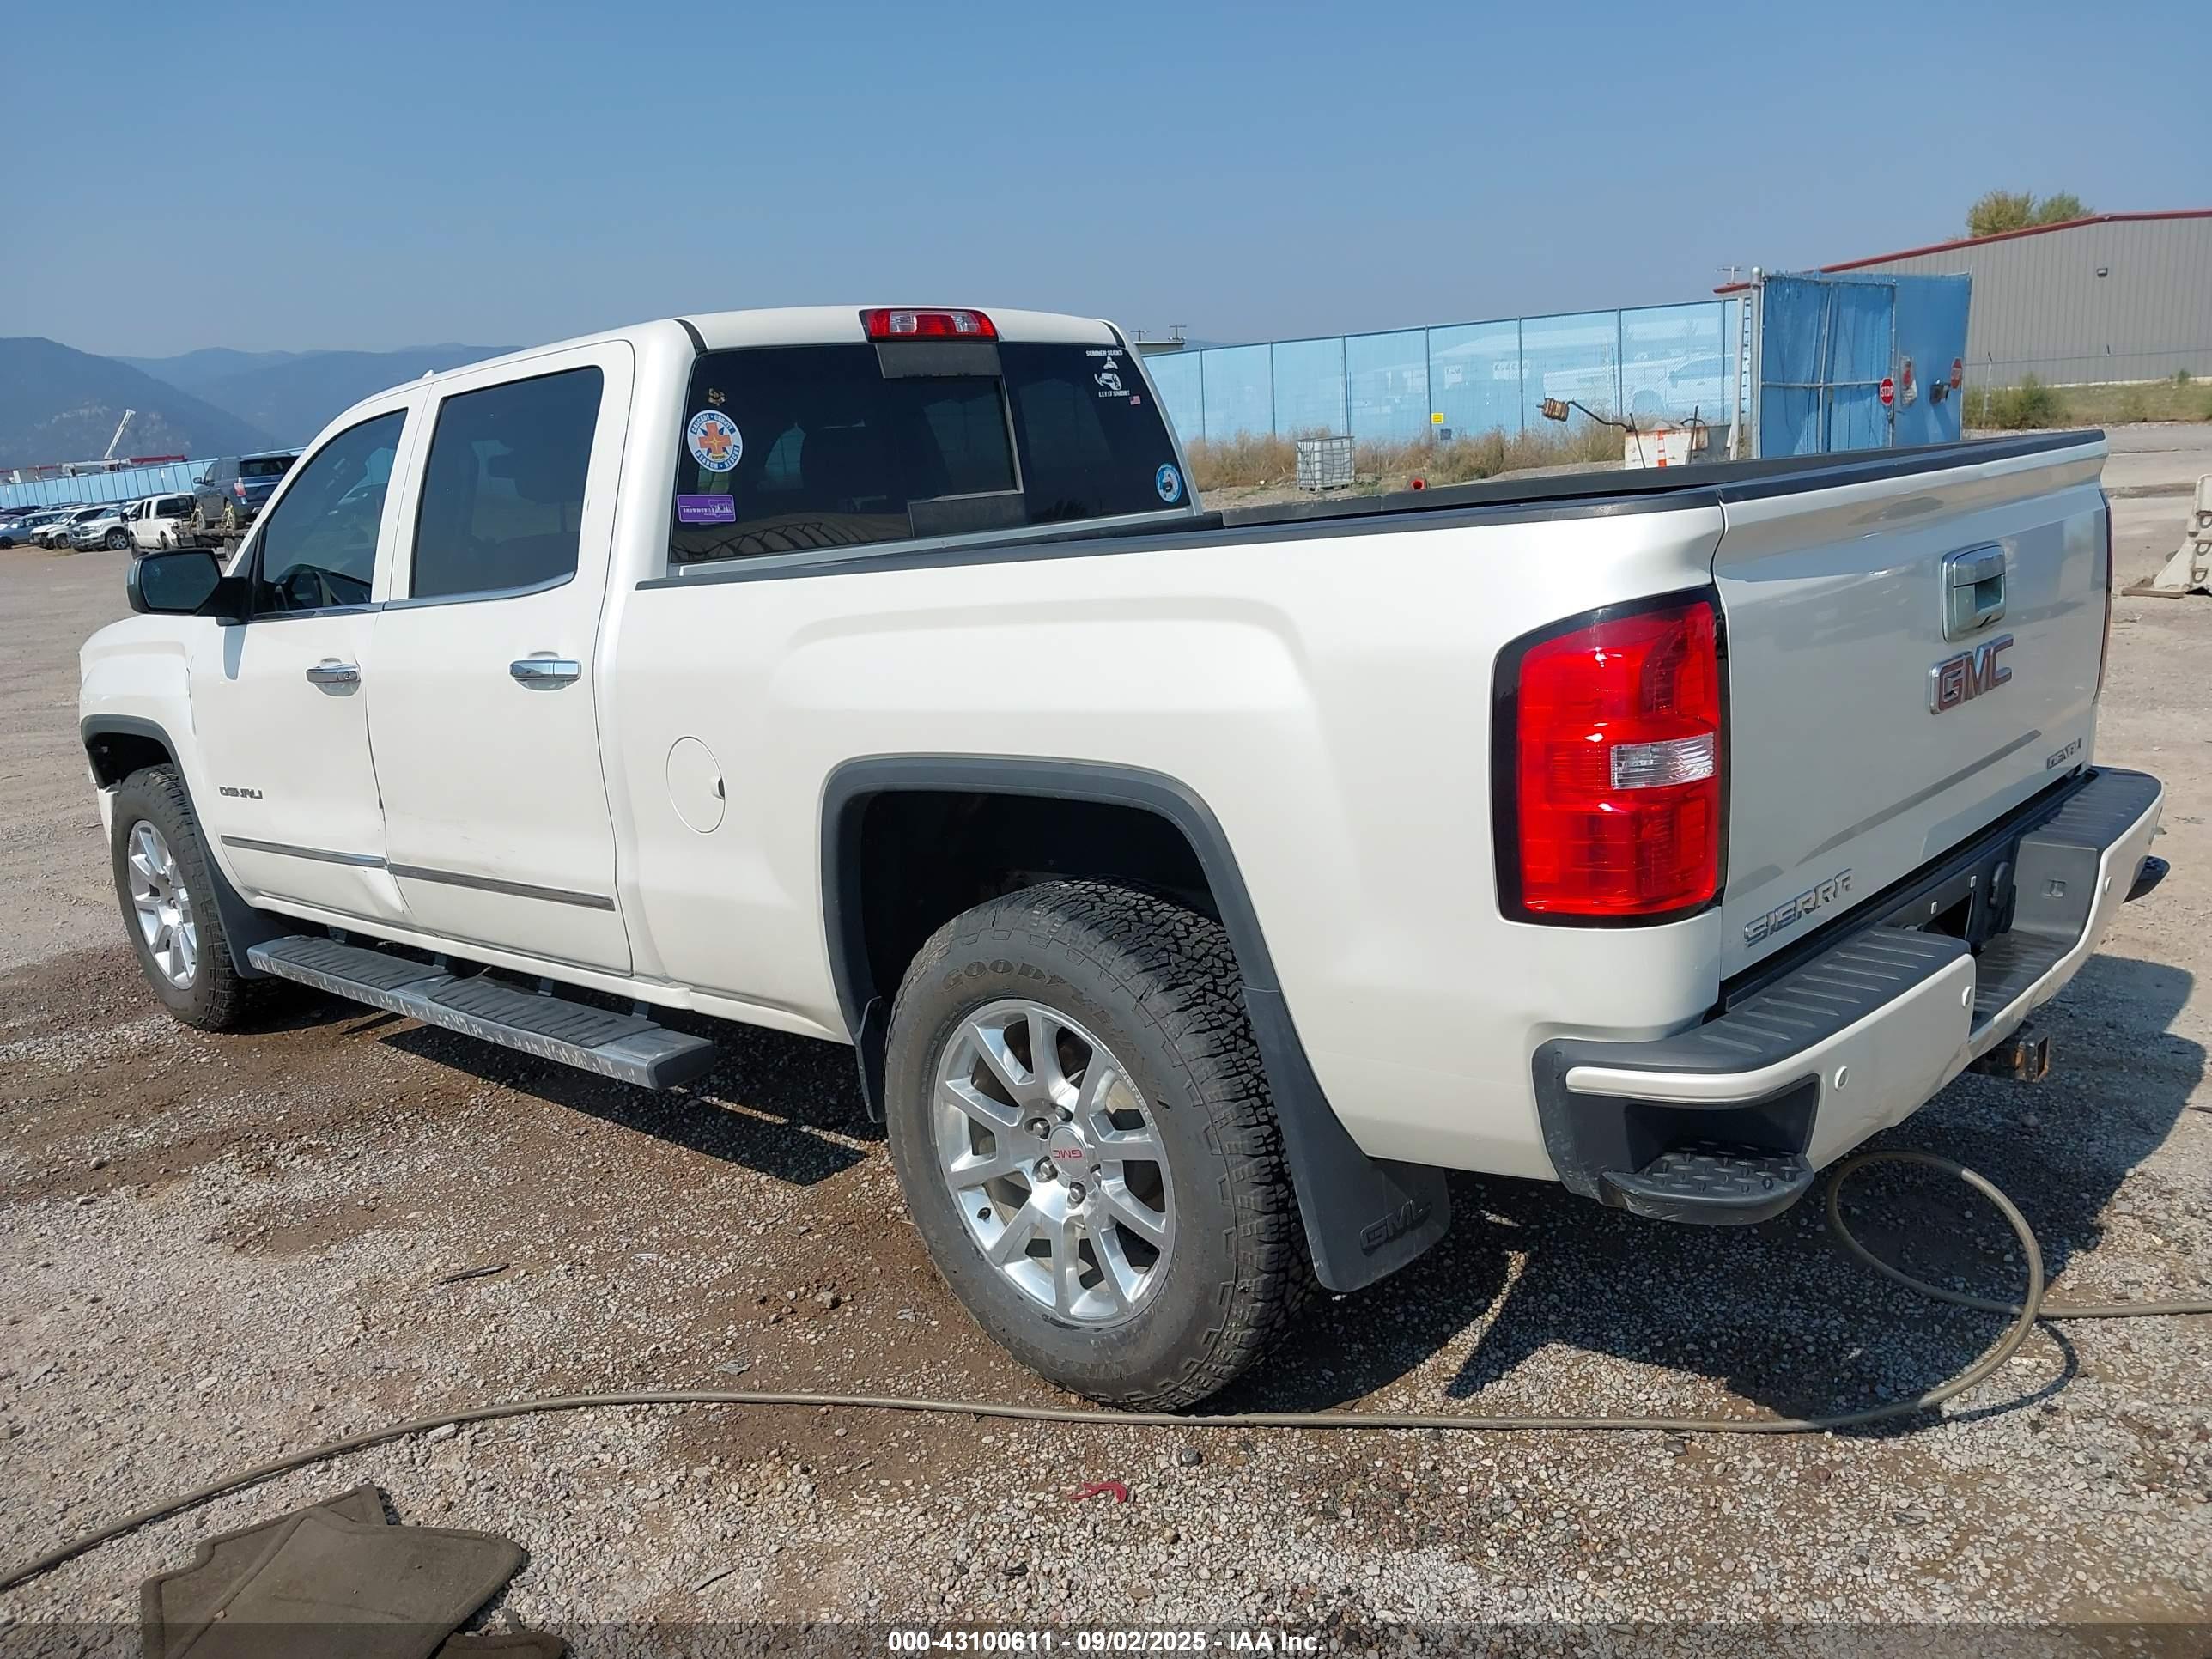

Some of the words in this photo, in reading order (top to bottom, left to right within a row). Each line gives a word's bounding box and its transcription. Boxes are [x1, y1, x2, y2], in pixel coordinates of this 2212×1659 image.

[1881, 386, 1893, 397] STOP
[690, 414, 710, 434] CASCADE
[714, 414, 734, 432] COUNTY
[696, 450, 719, 469] SEARCH
[724, 445, 740, 469] RESCUE
[1929, 633, 2014, 715] GMC
[2046, 738, 2082, 770] DENAI
[218, 786, 264, 799] DENALI
[1743, 868, 1853, 948] SIERRA
[1052, 1147, 1084, 1159] GMC
[1359, 1200, 1432, 1257] GMC
